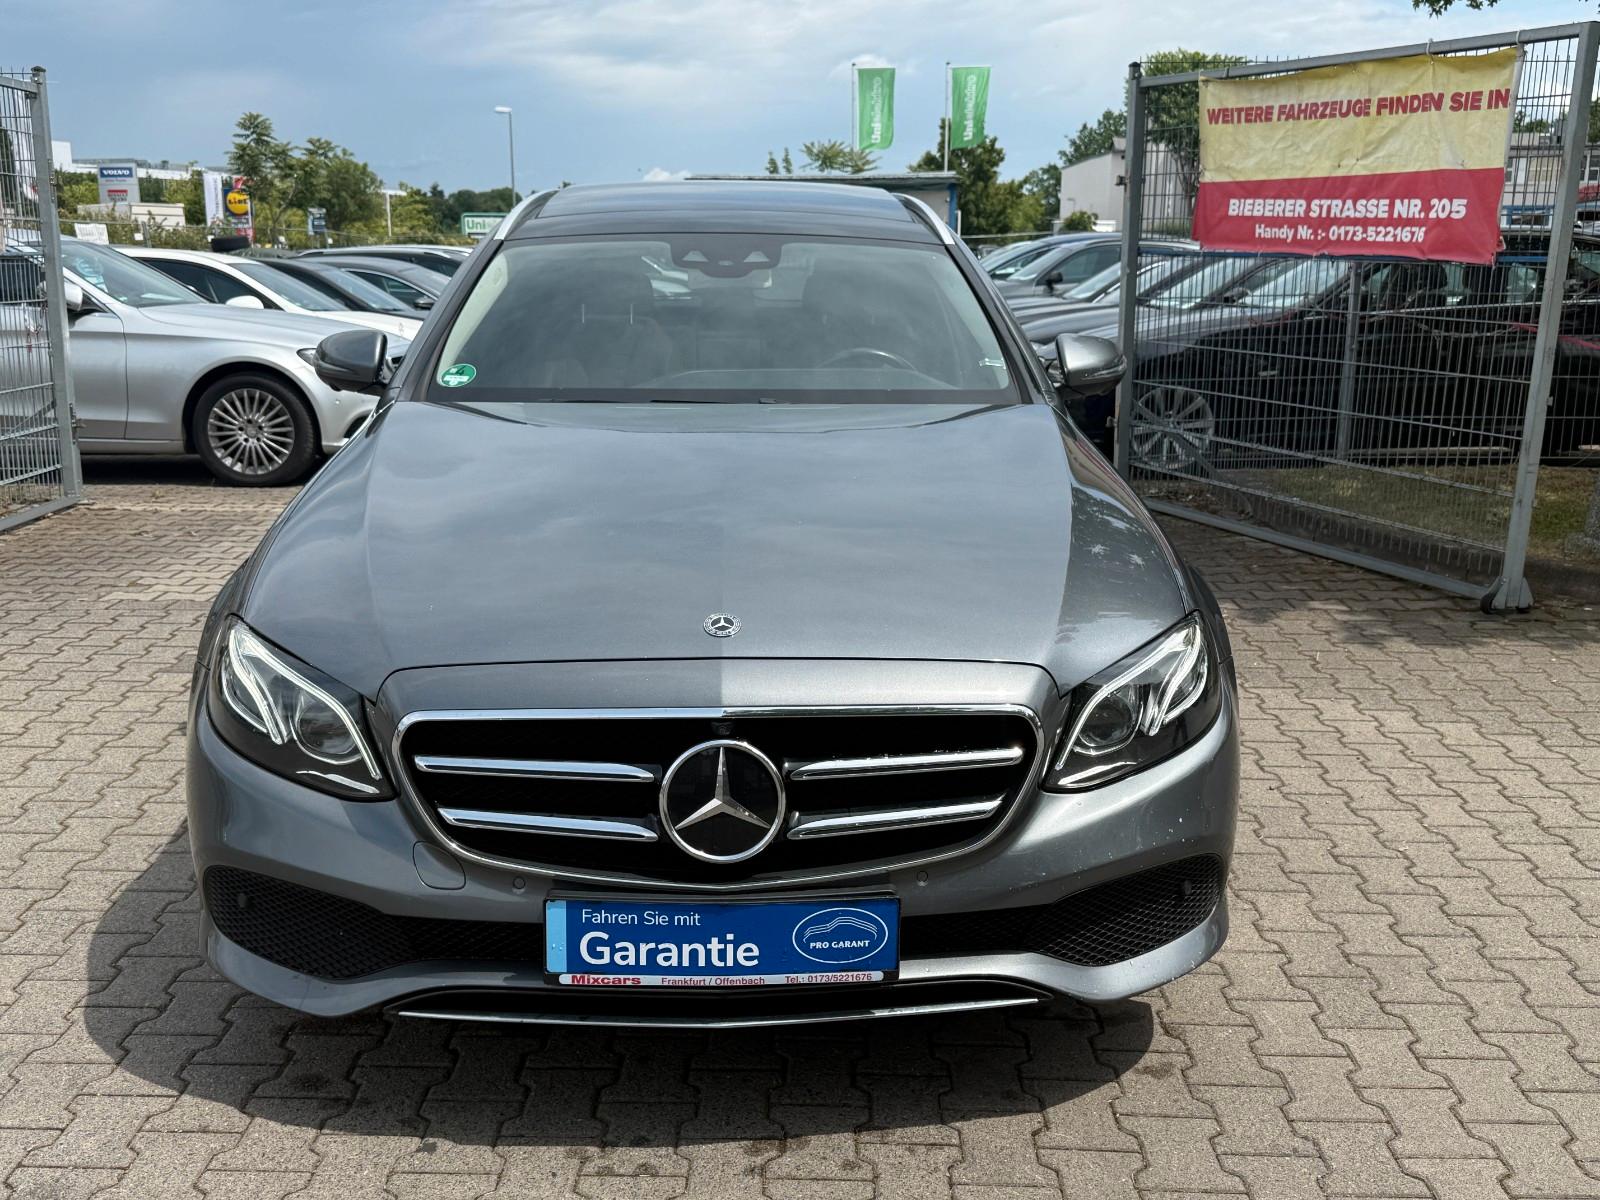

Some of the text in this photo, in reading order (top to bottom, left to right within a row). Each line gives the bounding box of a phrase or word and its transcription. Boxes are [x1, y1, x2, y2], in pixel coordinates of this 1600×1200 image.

[1207, 105, 1274, 125] WEITERE
[1277, 98, 1371, 122] FAHRZEUGE
[1376, 92, 1444, 116] FINDEN
[1449, 90, 1483, 112] SIE
[1228, 198, 1468, 219] BIEBERER STRASSE NR. 205
[1255, 223, 1294, 243] Handy
[1297, 225, 1315, 240] Nr.
[1329, 225, 1426, 243] 0173-5221676
[582, 909, 701, 927] Fahren Sie mit
[579, 931, 760, 967] Garantie
[810, 939, 870, 950] PRO GARANT
[571, 974, 641, 985] Mixcars
[661, 976, 706, 986] Frankfurt
[715, 975, 765, 986] Offenbach
[807, 973, 872, 983] 0173/5221676
